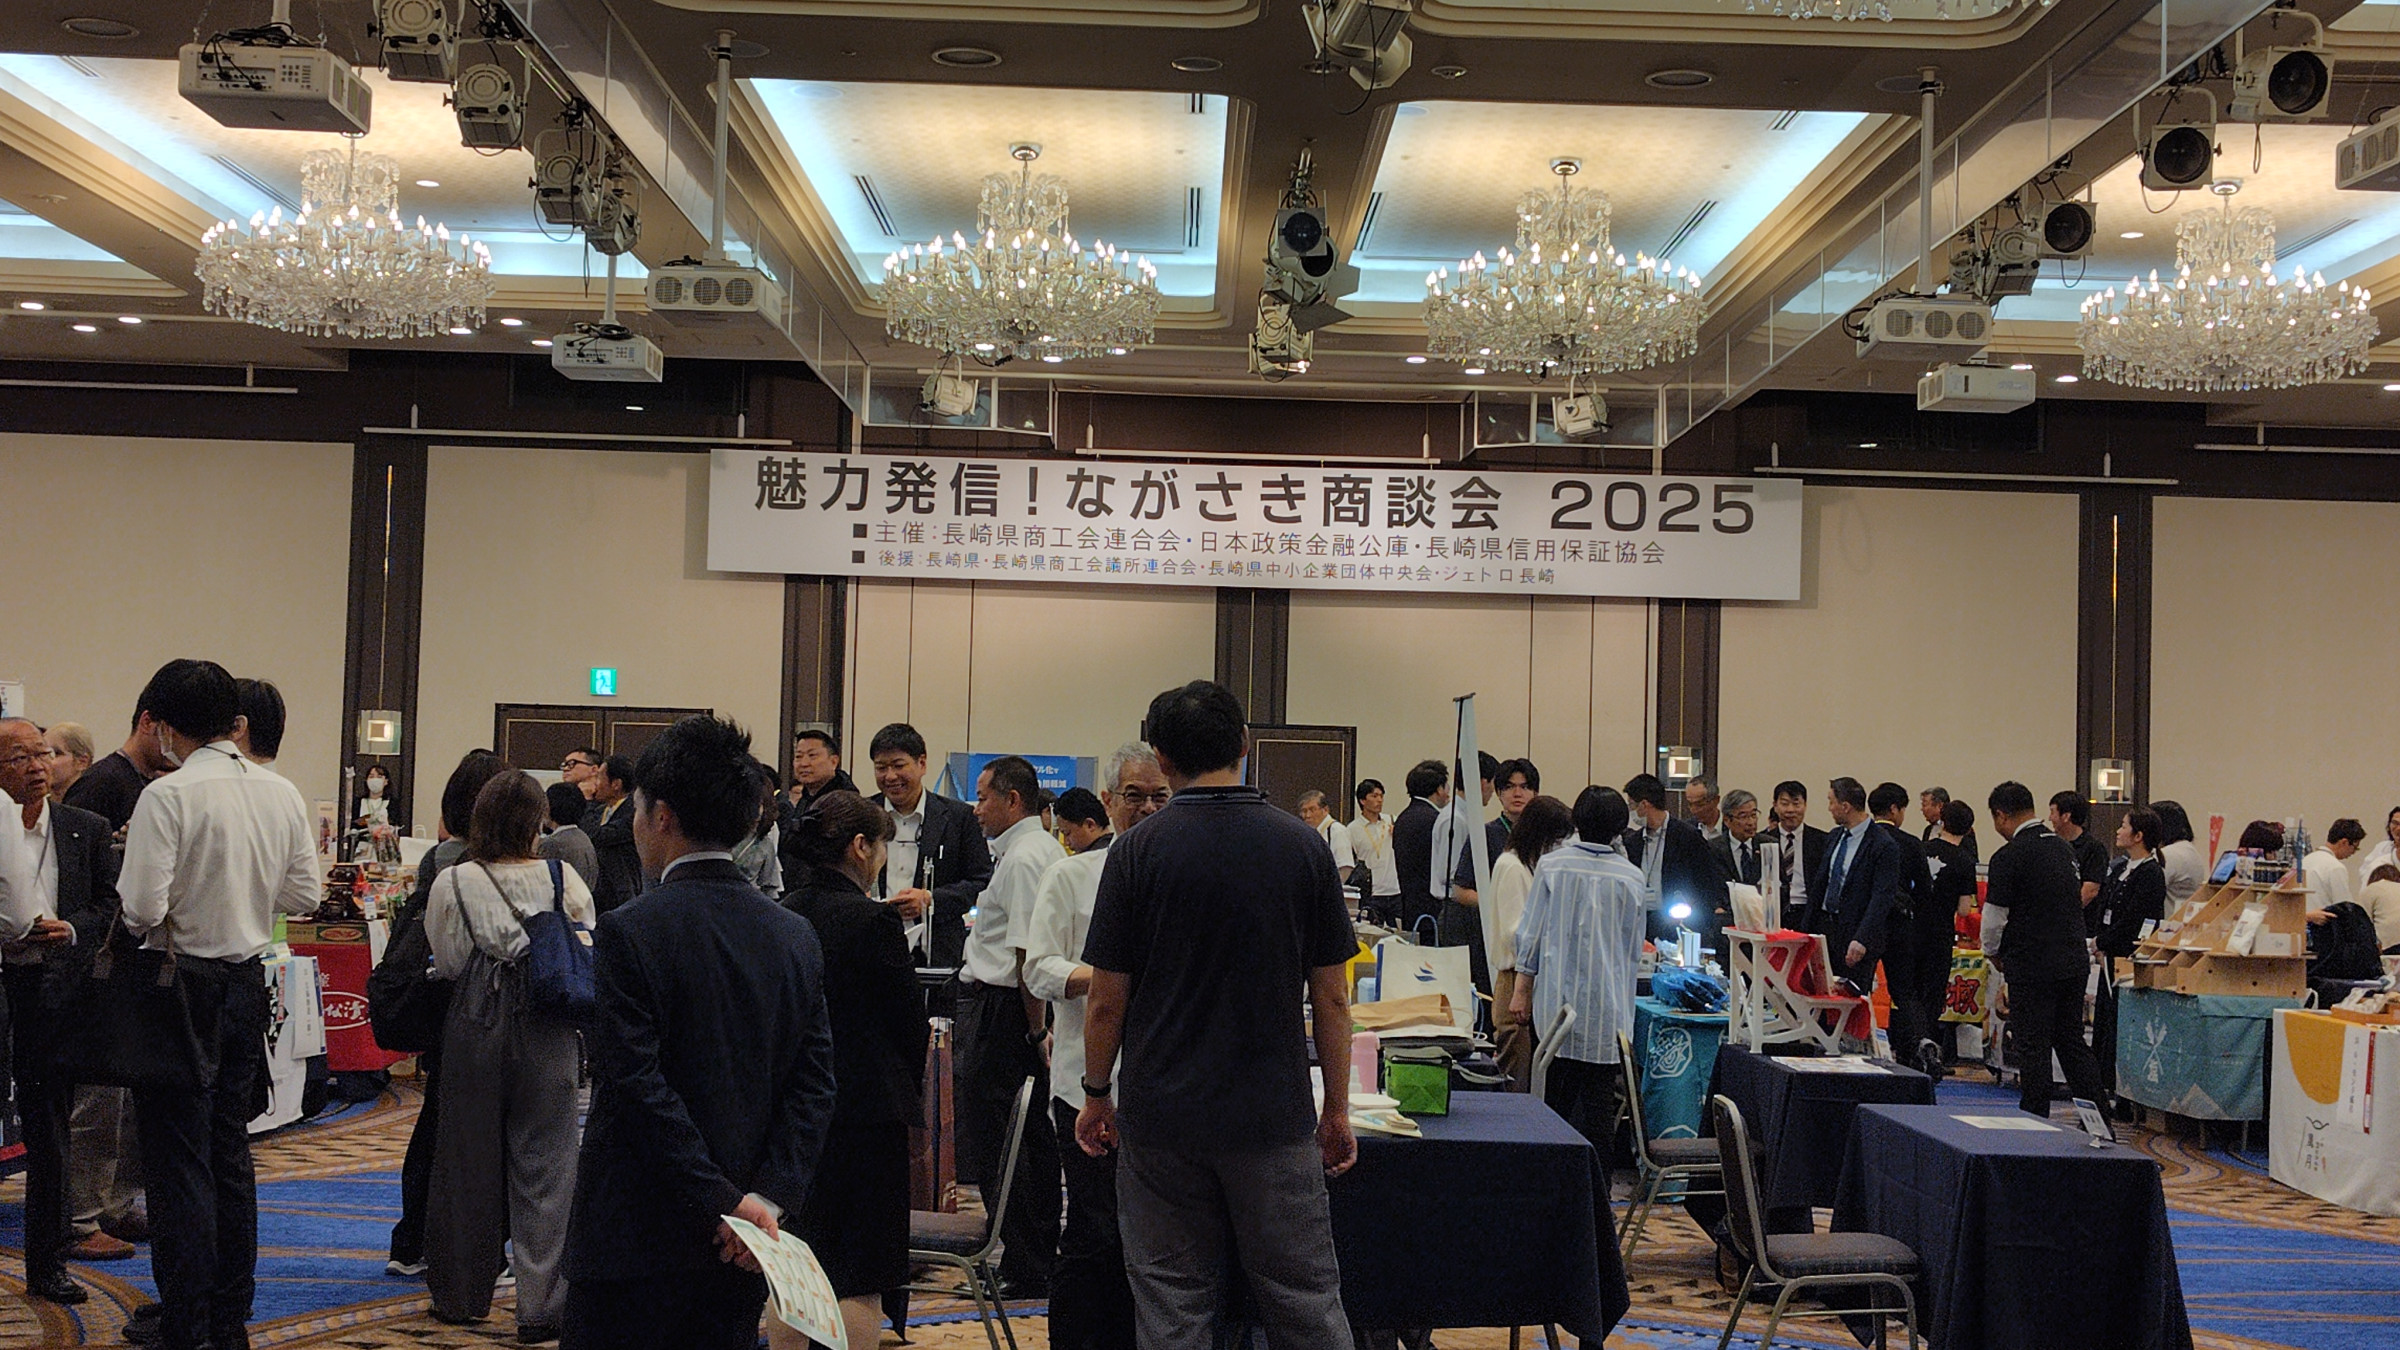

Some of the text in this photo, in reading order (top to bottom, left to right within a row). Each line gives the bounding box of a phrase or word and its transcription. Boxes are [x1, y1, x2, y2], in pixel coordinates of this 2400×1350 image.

[754, 455, 1754, 534] 魅力発信！ながさき商談会 2025
